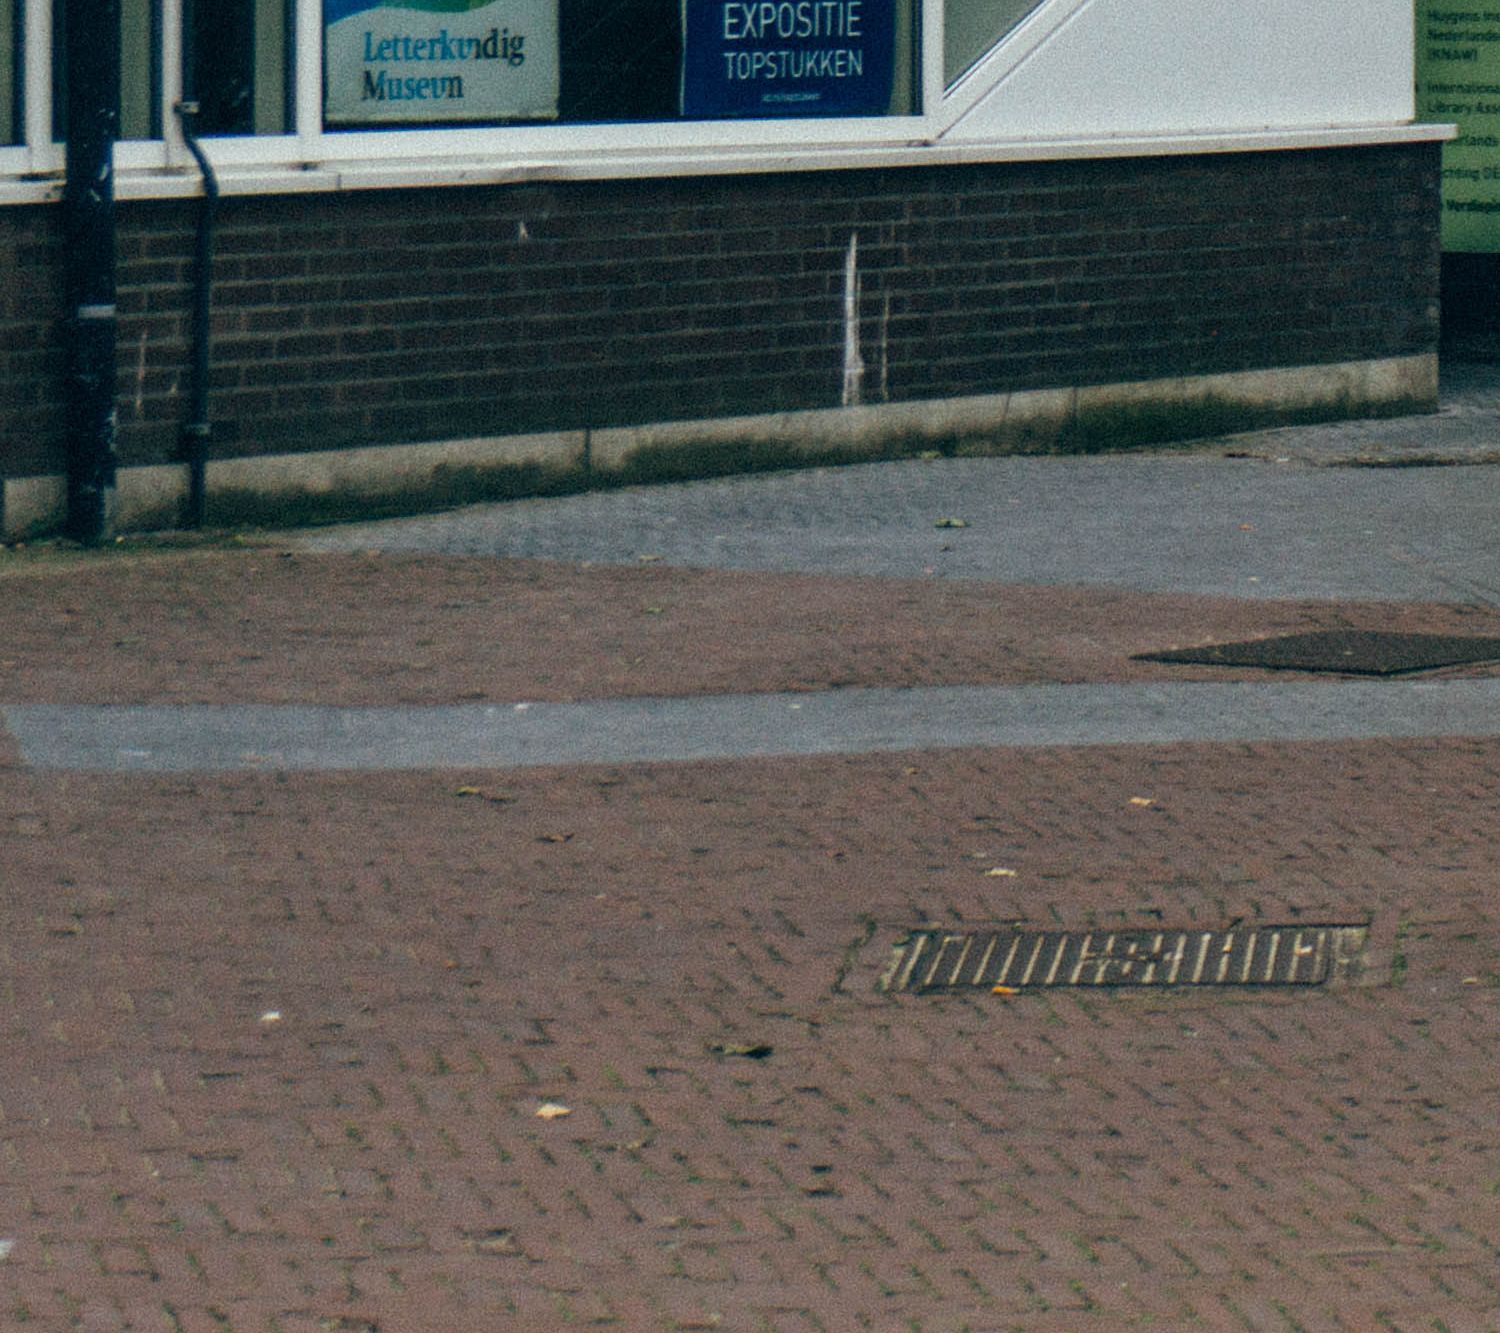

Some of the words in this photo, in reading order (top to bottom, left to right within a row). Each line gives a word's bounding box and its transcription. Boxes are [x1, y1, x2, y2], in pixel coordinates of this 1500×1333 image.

[724, 1, 863, 40] EXPOSITIE
[724, 50, 863, 79] TOPSTUKKEN
[1427, 101, 1472, 116] Library
